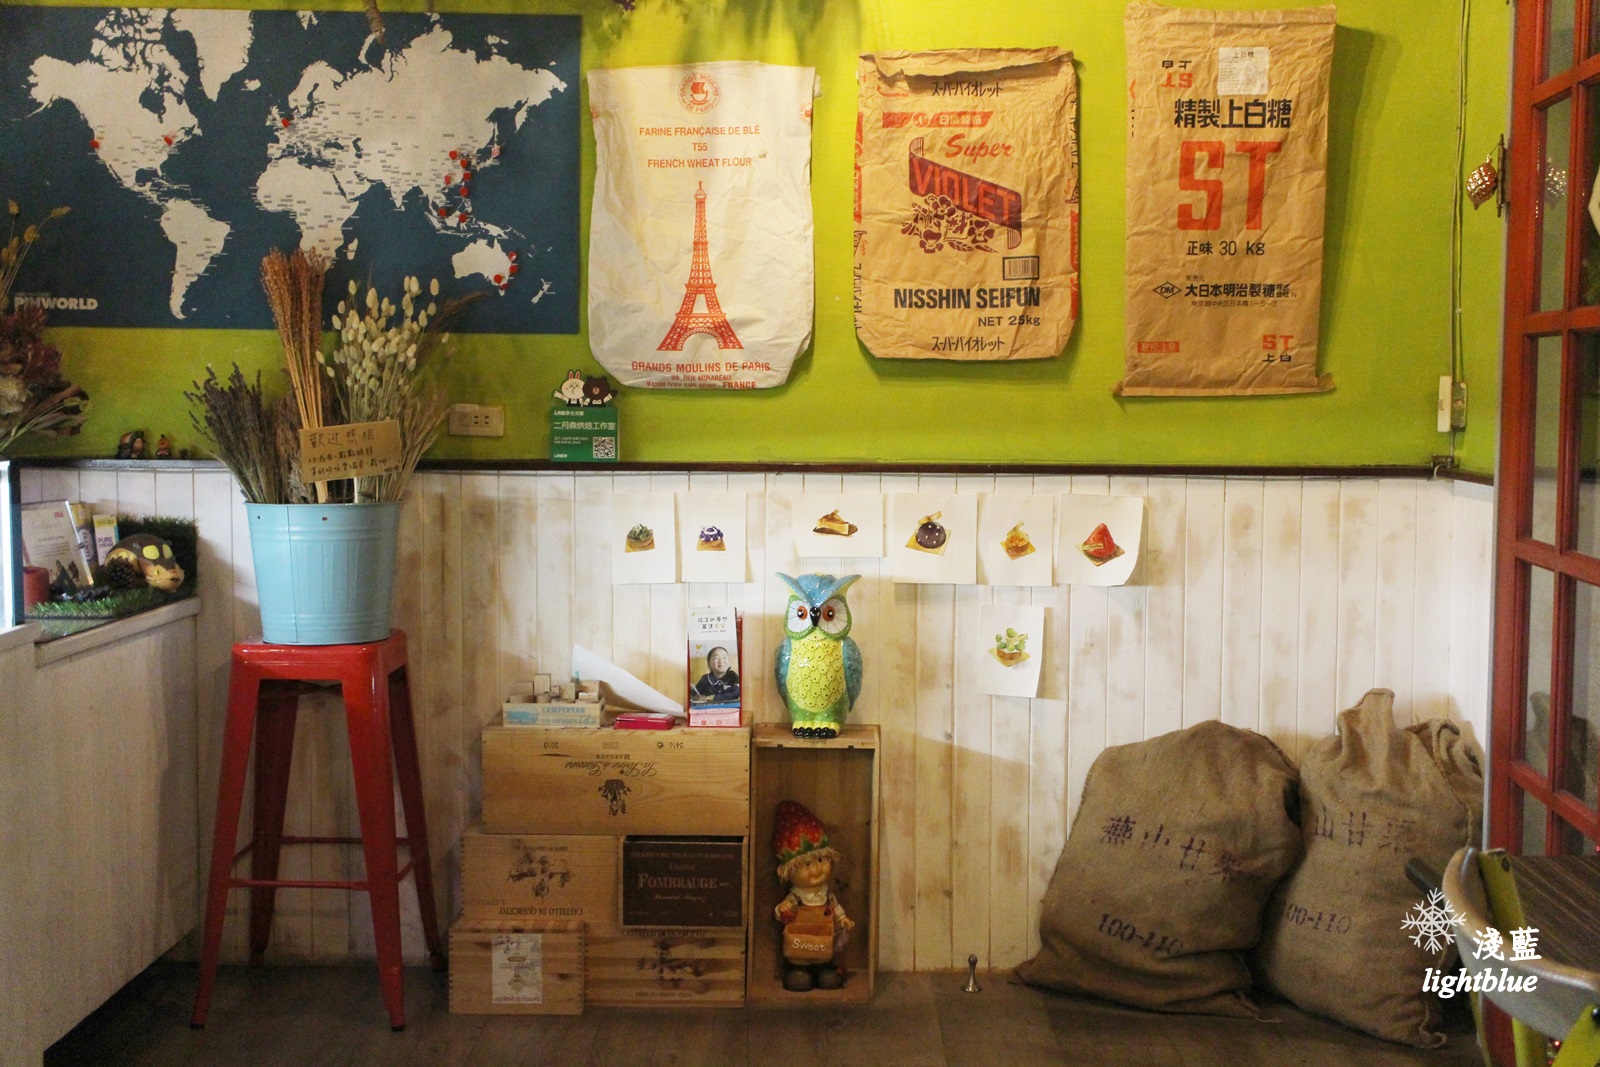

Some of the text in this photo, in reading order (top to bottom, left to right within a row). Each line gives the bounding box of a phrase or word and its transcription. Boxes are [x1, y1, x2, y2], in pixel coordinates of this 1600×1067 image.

[700, 73, 720, 97] MOULINS
[1160, 72, 1194, 88] ST
[695, 102, 714, 113] PARIS
[1174, 98, 1293, 129] 精製上白糖
[639, 124, 760, 138] FARINE FRANÇAISE DE BLÉ
[692, 142, 708, 152] T55
[945, 133, 1015, 164] Super
[647, 157, 752, 169] FRENCH WHEAT FLOUR
[911, 157, 1018, 226] VIOLET
[1176, 140, 1283, 231] ST
[1186, 240, 1266, 256] 正味 30 kg
[1160, 286, 1175, 294] DM
[893, 286, 1041, 309] NISSHIN SEIFUN
[978, 315, 1041, 327] NET 25kg
[1262, 334, 1295, 351] ST
[1262, 353, 1292, 363] 上白
[631, 360, 771, 373] GRANDS MOULINS DE PARIS
[722, 381, 757, 390] FRANCE
[538, 906, 547, 915] DI
[549, 906, 583, 915] CASTELLO
[791, 938, 826, 952] Sweet
